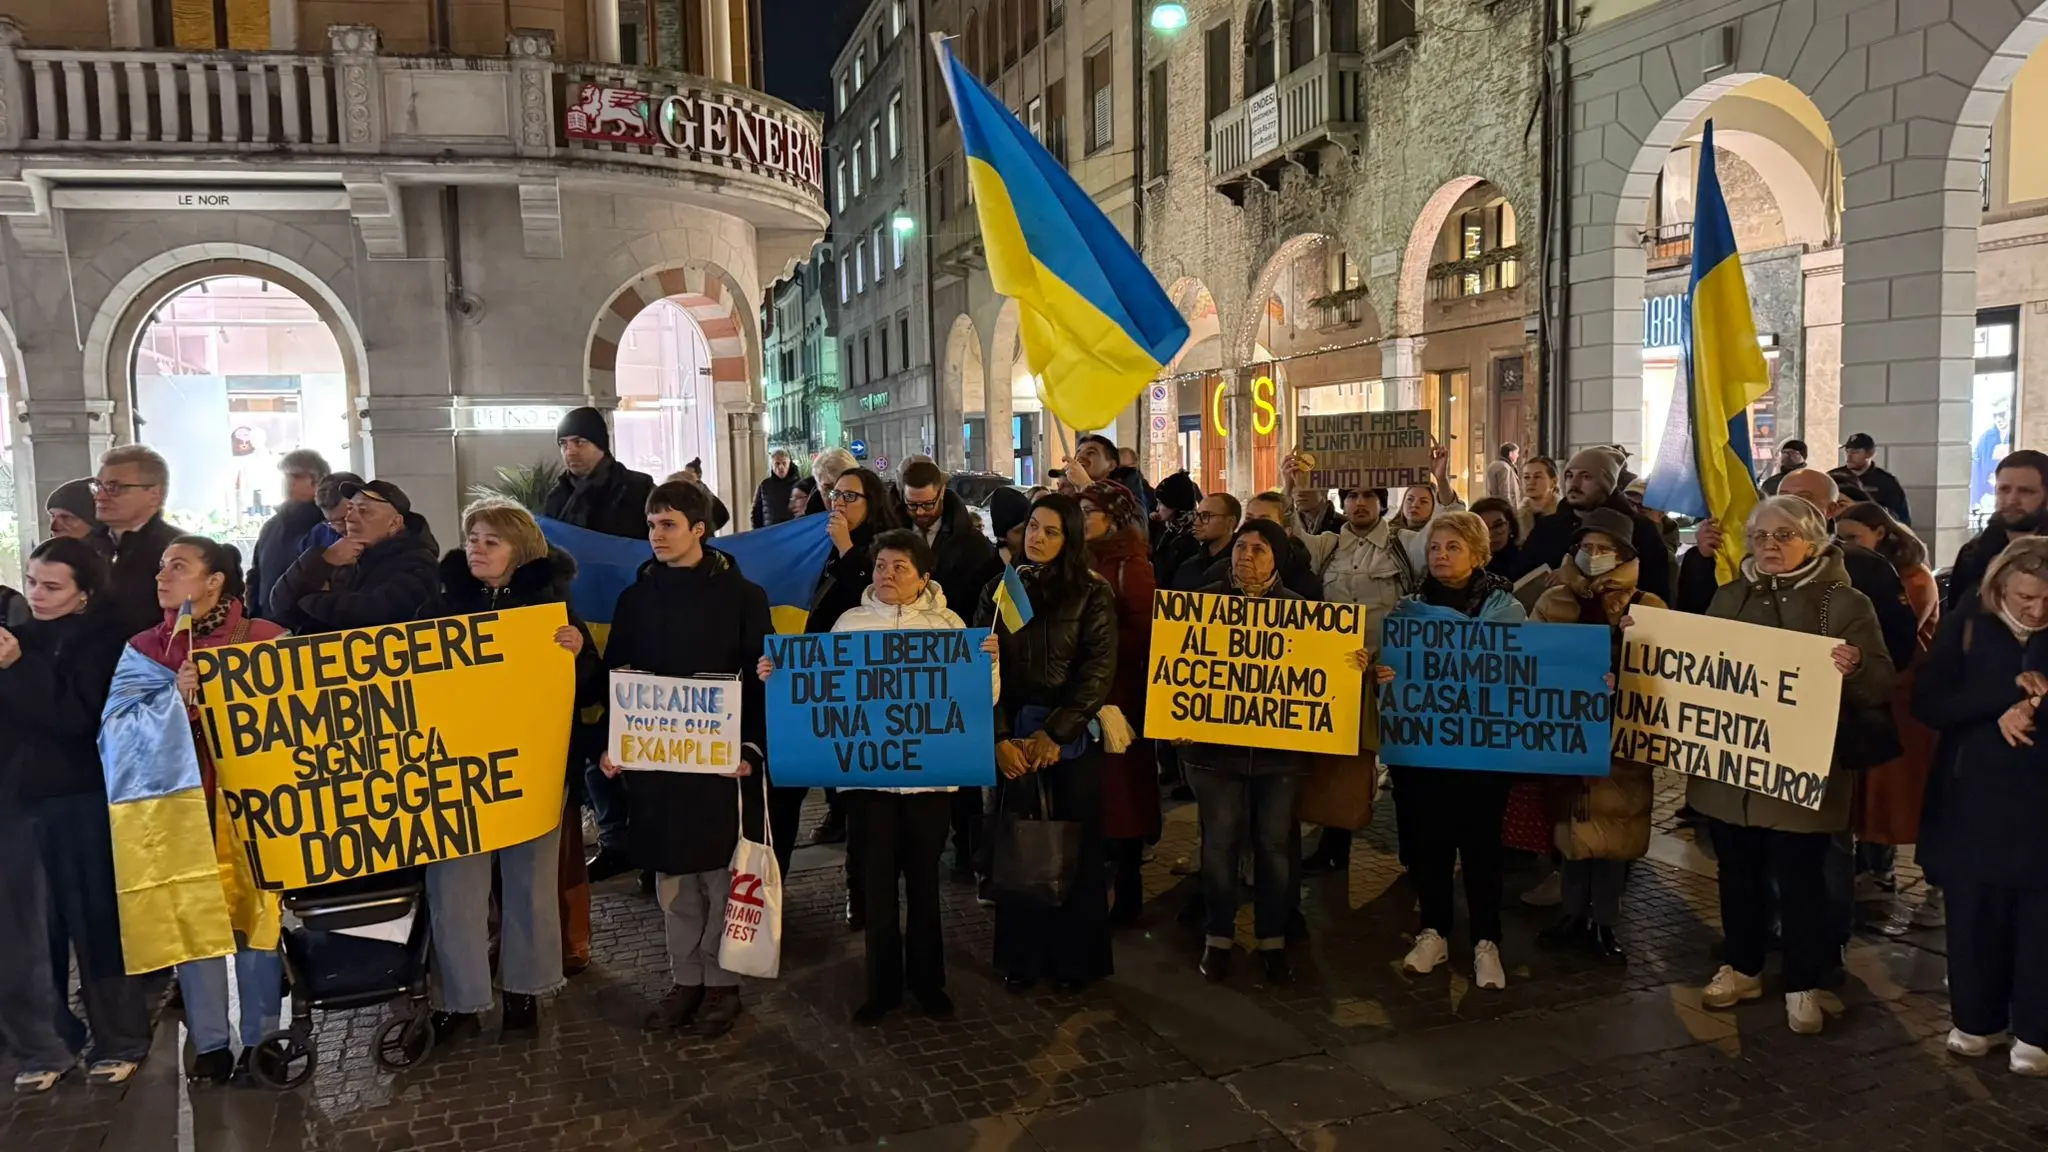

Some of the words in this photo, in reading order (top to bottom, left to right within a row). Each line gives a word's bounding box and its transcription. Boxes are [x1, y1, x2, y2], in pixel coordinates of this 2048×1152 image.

[178, 195, 193, 205] LE
[198, 195, 230, 205] NOIR
[1371, 411, 1418, 431] PACE
[1317, 434, 1350, 451] UNA
[1353, 430, 1424, 449] VITTORIA
[1310, 469, 1360, 488] AIUTO
[1365, 467, 1429, 487] TOTALE
[1154, 591, 1203, 622] NON
[1208, 596, 1360, 634] ABITUIAMOCI
[767, 635, 828, 670] VITA
[833, 634, 853, 666] E
[1180, 625, 1217, 656] AL
[1229, 628, 1293, 660] BUIO:
[1383, 619, 1522, 651] RIPORTATE
[193, 613, 504, 704] PROTEGGERE
[1406, 653, 1412, 680] I
[1423, 652, 1537, 687] BAMBINI
[791, 670, 846, 704] DUE
[1152, 656, 1327, 697] ACCENDIAMO
[205, 707, 222, 758] I
[227, 680, 417, 757] BAMBINI
[1380, 683, 1397, 712] A
[1478, 687, 1503, 717] IL
[1508, 687, 1610, 722] FUTURO
[625, 713, 678, 734] YOU'RE
[685, 718, 722, 736] OUR
[812, 704, 871, 738] UNA
[1380, 716, 1433, 746] NON
[1440, 717, 1463, 746] SI
[1471, 718, 1588, 754] DEPORTA
[1617, 690, 1669, 729] UNA
[1678, 702, 1771, 753] FERITA
[292, 727, 450, 779] SIGNIFICA
[621, 734, 732, 766] EXAMPLE!
[833, 739, 923, 773] VOCE
[1614, 727, 1711, 778] APERTA
[1718, 749, 1742, 785] IN
[1744, 756, 1829, 807] EUROPA
[223, 748, 523, 839] PROTEGGERE
[244, 840, 284, 890] IL
[301, 800, 481, 885] DOMANI
[724, 903, 762, 925] RIANO
[726, 923, 757, 943] FEST
